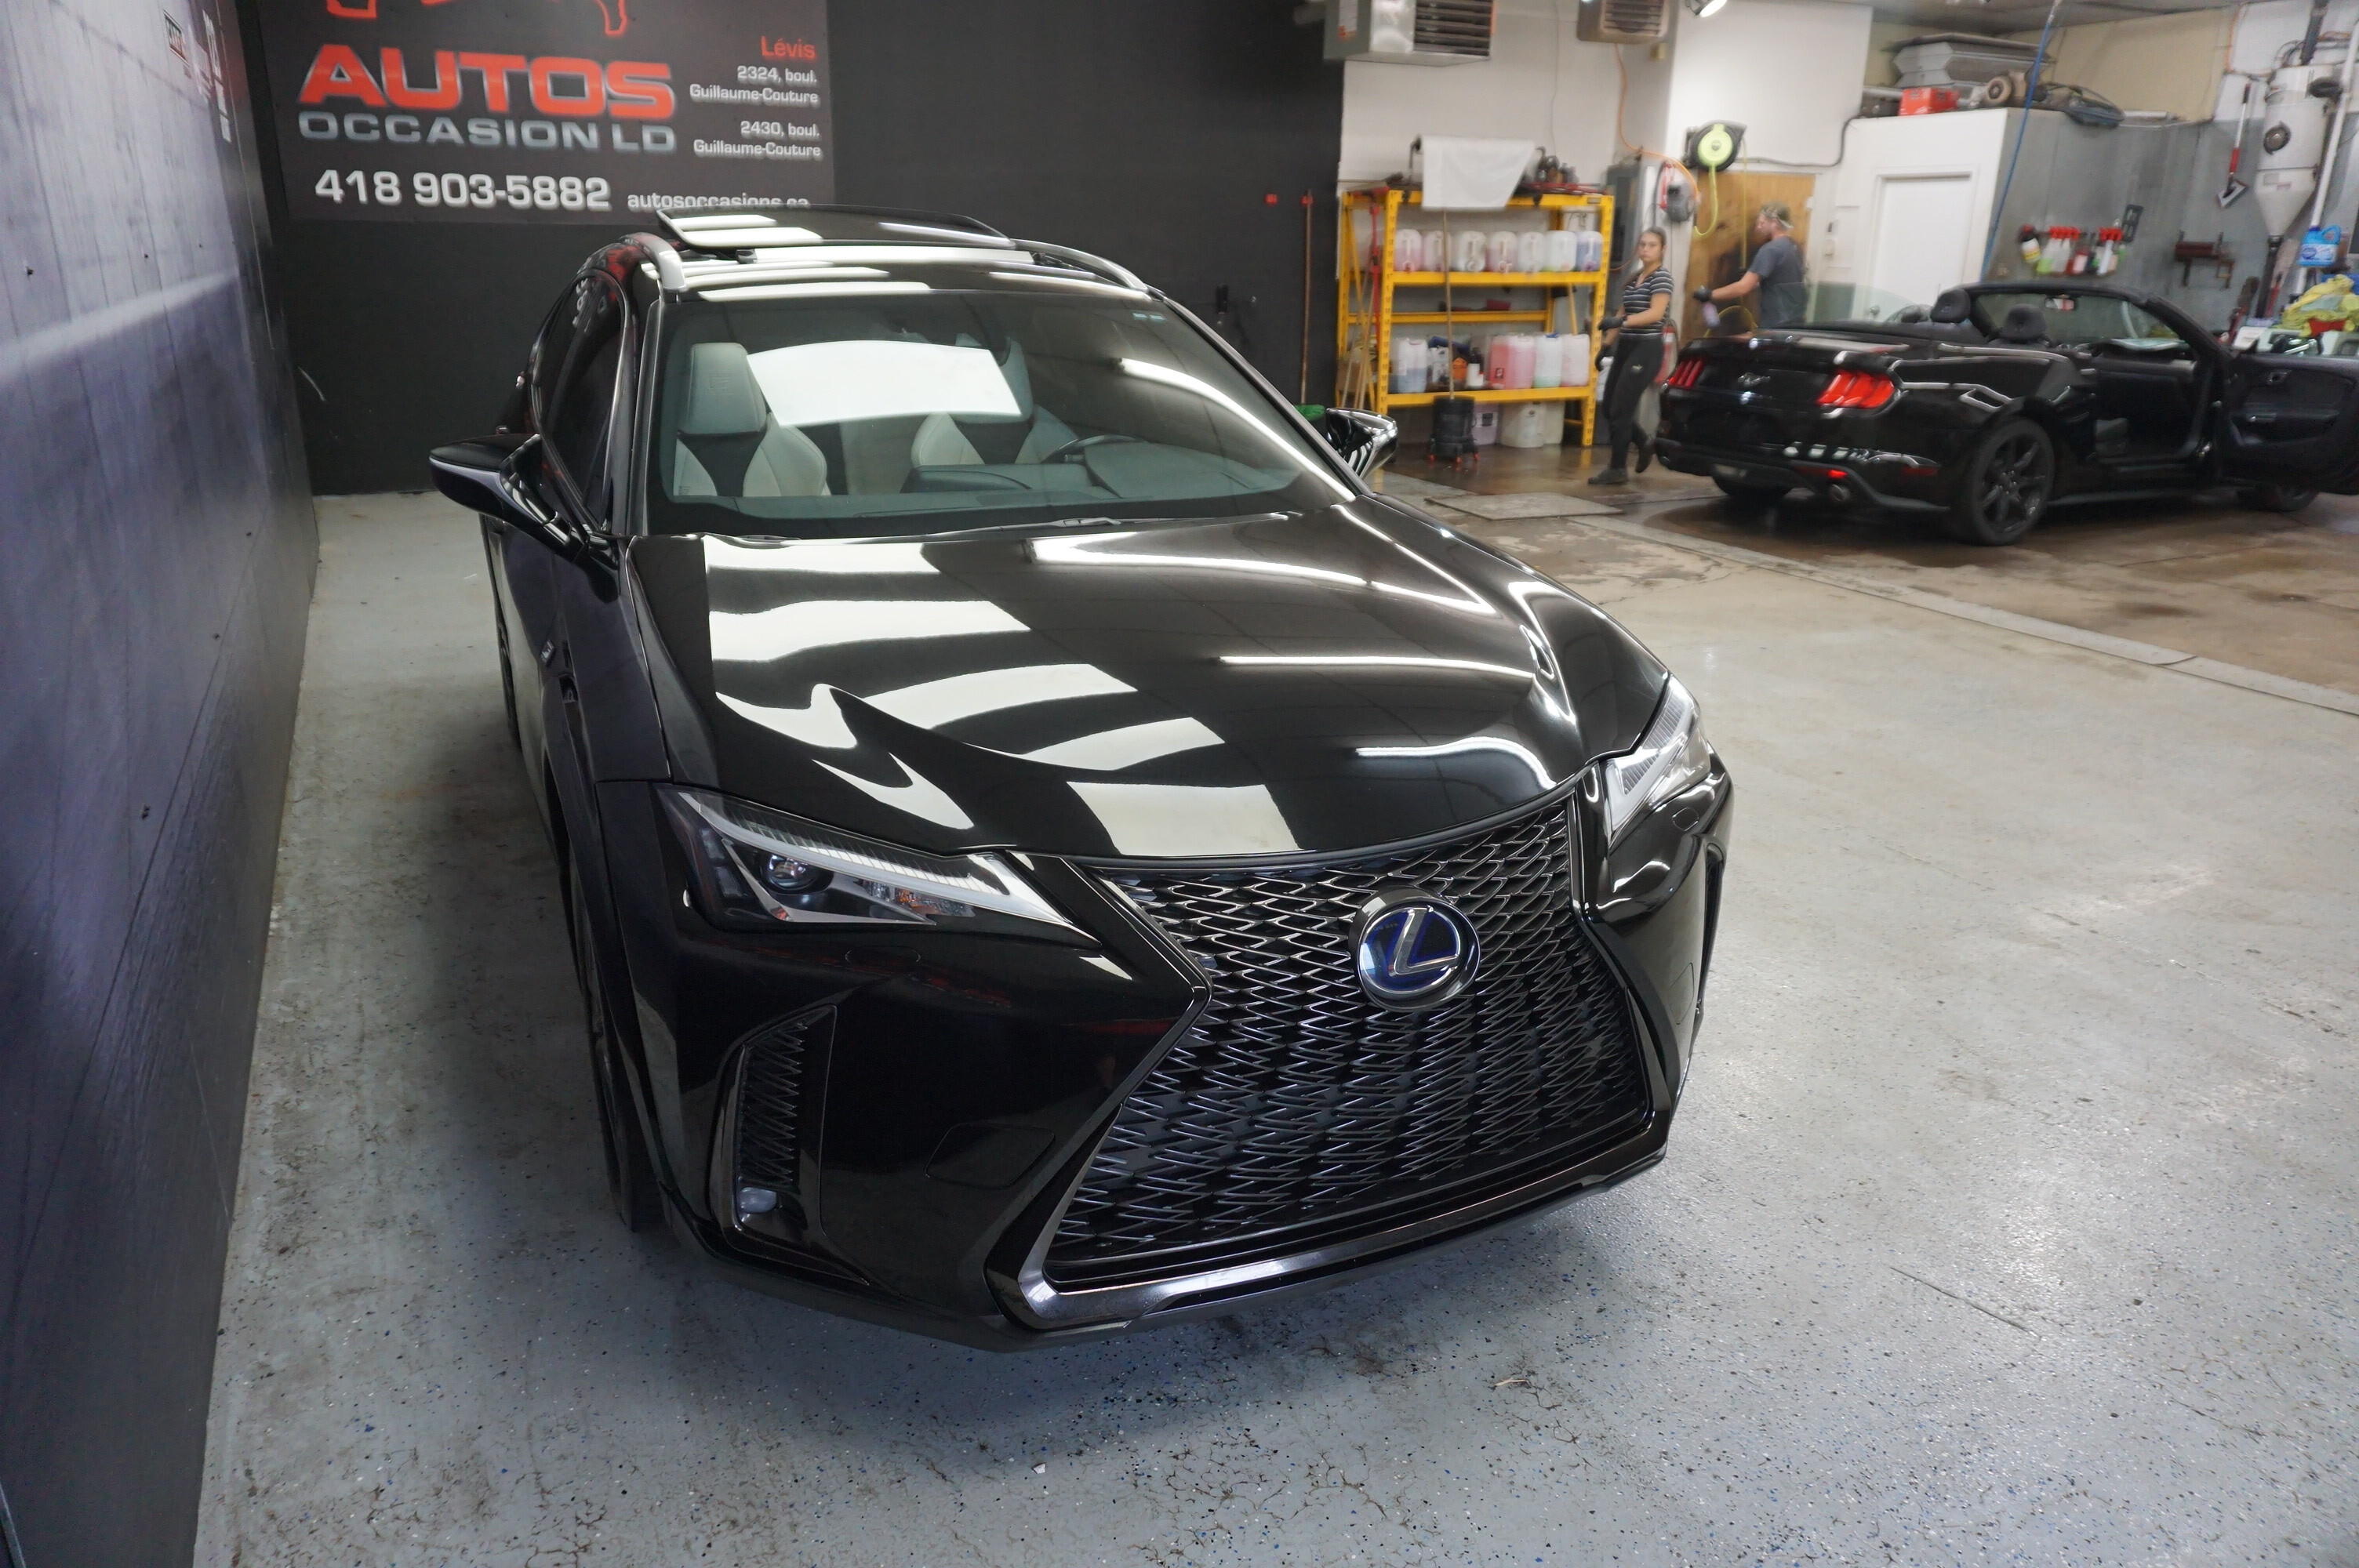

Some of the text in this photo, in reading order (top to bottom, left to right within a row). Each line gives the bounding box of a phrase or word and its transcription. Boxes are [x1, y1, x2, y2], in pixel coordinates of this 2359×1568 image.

[760, 36, 818, 60] Lévis
[298, 43, 676, 120] AUTOS
[737, 65, 818, 85] 2324, boul.
[689, 83, 820, 107] Guillaume-Couture
[298, 111, 676, 153] OCCASION LD
[740, 120, 820, 141] 2430, boul.
[693, 139, 823, 159] Guillaume-Couture
[315, 169, 612, 211] 418 903-5882
